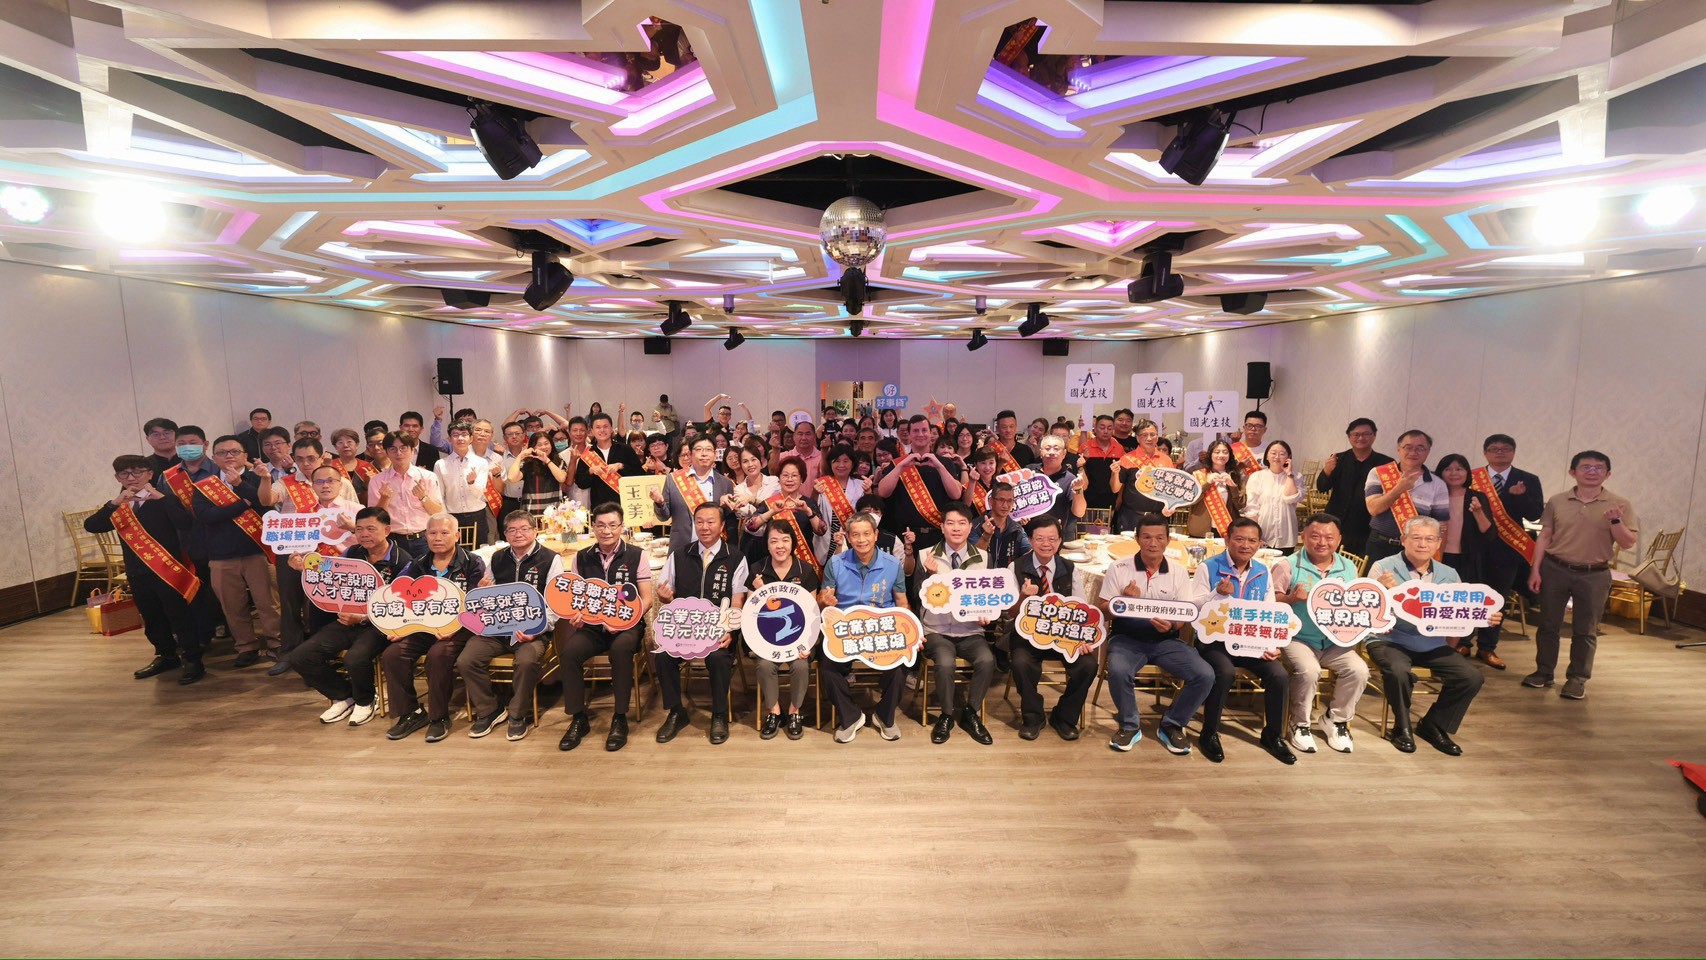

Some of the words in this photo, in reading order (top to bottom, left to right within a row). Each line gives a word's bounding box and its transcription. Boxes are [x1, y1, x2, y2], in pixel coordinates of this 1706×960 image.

[1070, 387, 1108, 399] 國光生技
[1137, 396, 1176, 408] 國光生技
[1189, 416, 1231, 428] 國光生技
[267, 517, 321, 529] 共融無界
[265, 529, 321, 542] 職場無限
[306, 569, 376, 589] 職場不設限
[951, 576, 1005, 590] 多元友善
[555, 576, 618, 603] 友善職場
[1323, 589, 1382, 608] 心世界
[1420, 590, 1485, 604] 用心聘用
[371, 601, 406, 617] 有礙
[411, 599, 460, 615] 更有愛
[465, 591, 530, 613] 平等就業
[572, 596, 635, 621] 共築未來
[960, 593, 1014, 607] 幸福台中
[480, 605, 543, 626] 有你更好
[657, 608, 721, 625] 企業支持
[1027, 600, 1088, 623] 臺中有你
[1127, 603, 1194, 617] 臺中市政府勞工局
[1228, 607, 1289, 625] 攜手共融
[1315, 608, 1372, 628] 無界限
[1422, 606, 1488, 621] 用愛成就
[662, 623, 726, 640] 多元共好
[833, 616, 897, 639] 企業有愛
[1035, 618, 1097, 642] 更有溫度
[1228, 623, 1289, 641] 讓愛無礙
[772, 644, 807, 660] 勞工局
[842, 633, 907, 656] 職場無礙
